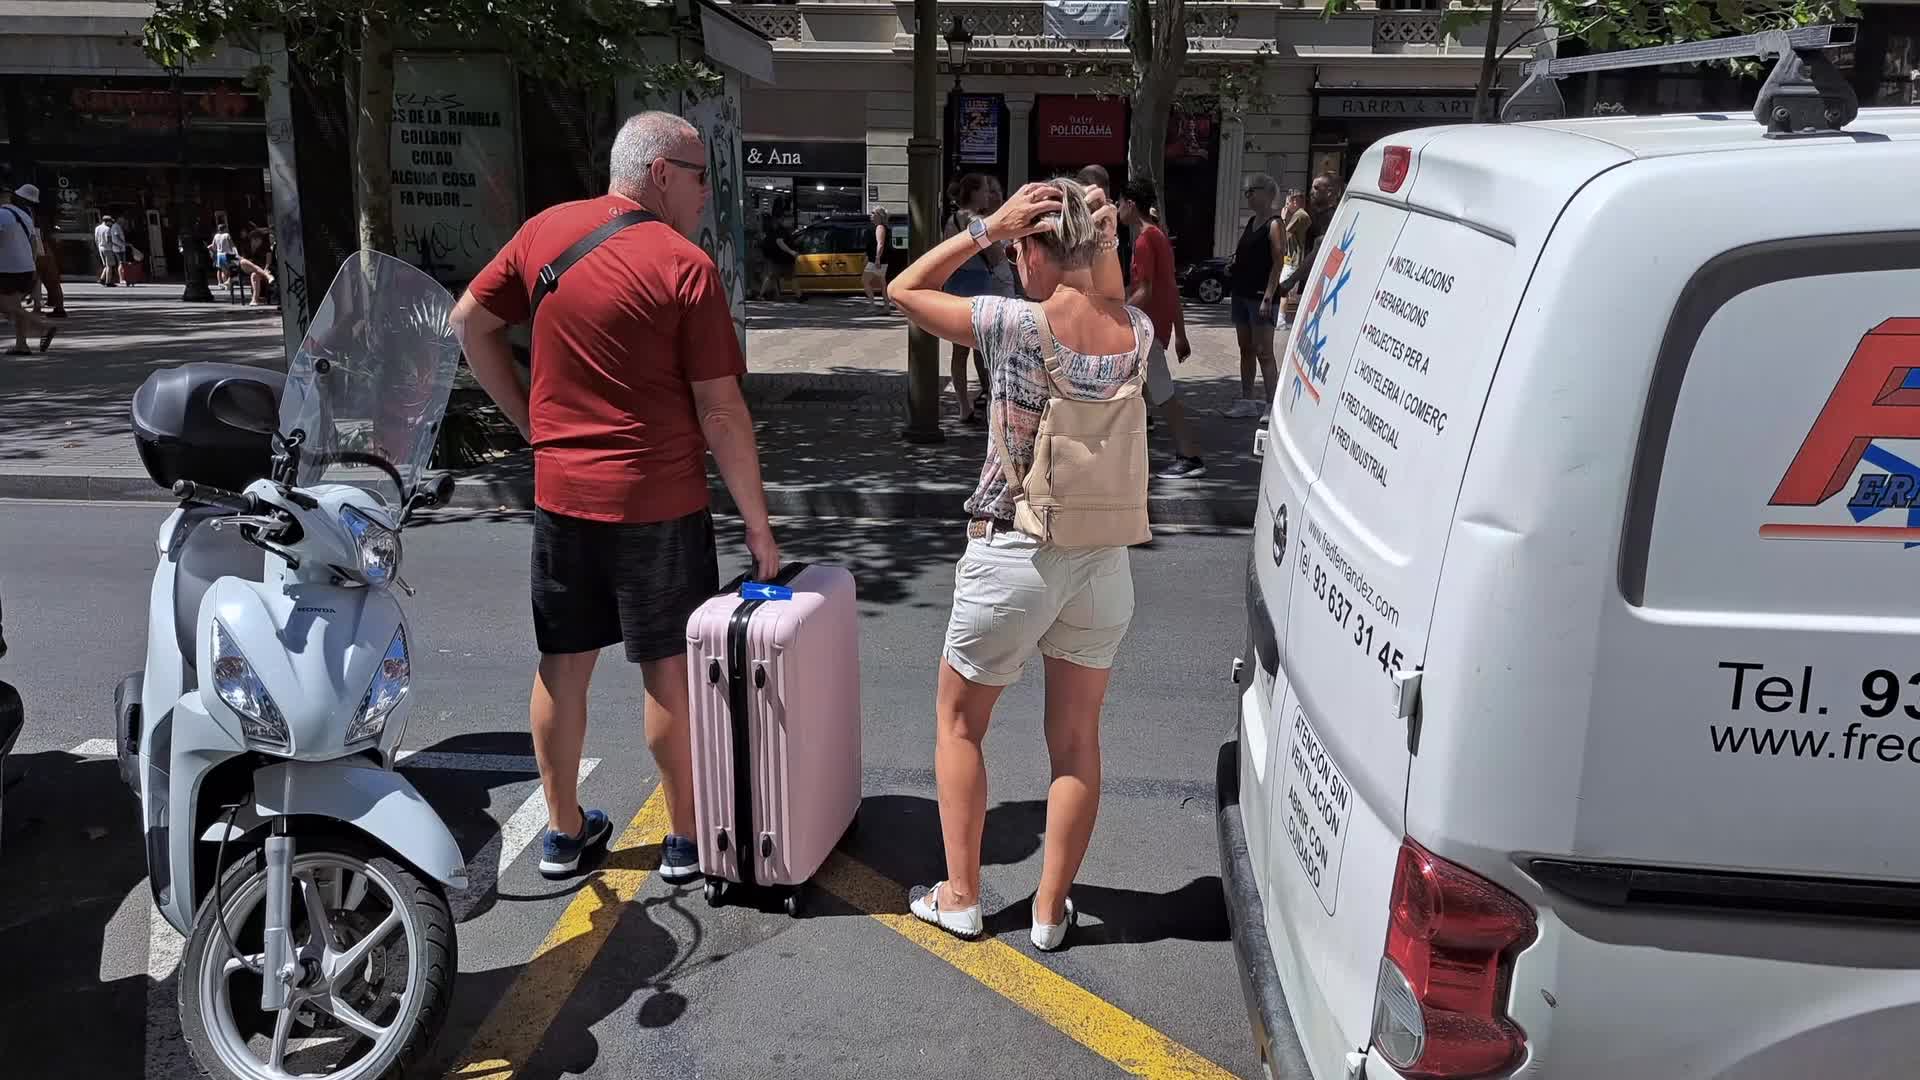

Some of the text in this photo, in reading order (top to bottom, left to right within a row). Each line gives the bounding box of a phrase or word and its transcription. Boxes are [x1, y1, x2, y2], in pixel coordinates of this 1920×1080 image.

[409, 109, 425, 123] DE
[428, 109, 442, 124] LA
[1050, 125, 1112, 135] POLIORAMA
[1342, 100, 1406, 113] BARRA
[412, 151, 453, 166] COLAU
[443, 172, 477, 187] COSA
[748, 147, 803, 164] & Ana
[400, 191, 415, 206] FA
[1378, 290, 1429, 328] REPARACIONS
[1366, 324, 1430, 376] PROJECTES PER A
[1344, 392, 1399, 450] FRED COMERCIAL
[1403, 393, 1448, 436] COMERÇ
[1335, 425, 1388, 488] FRED INDUSTRIAL
[1307, 520, 1400, 629] www.fredfernandez.com
[1299, 540, 1404, 680] Tel. 93 637 31 45
[1718, 661, 1828, 715] Tel.
[1294, 714, 1348, 812] ATENCIÓN SIN
[1291, 742, 1340, 838] VENTILACIÓN
[1288, 784, 1328, 870] ABRIR CON
[1288, 815, 1321, 888] CUIDADO
